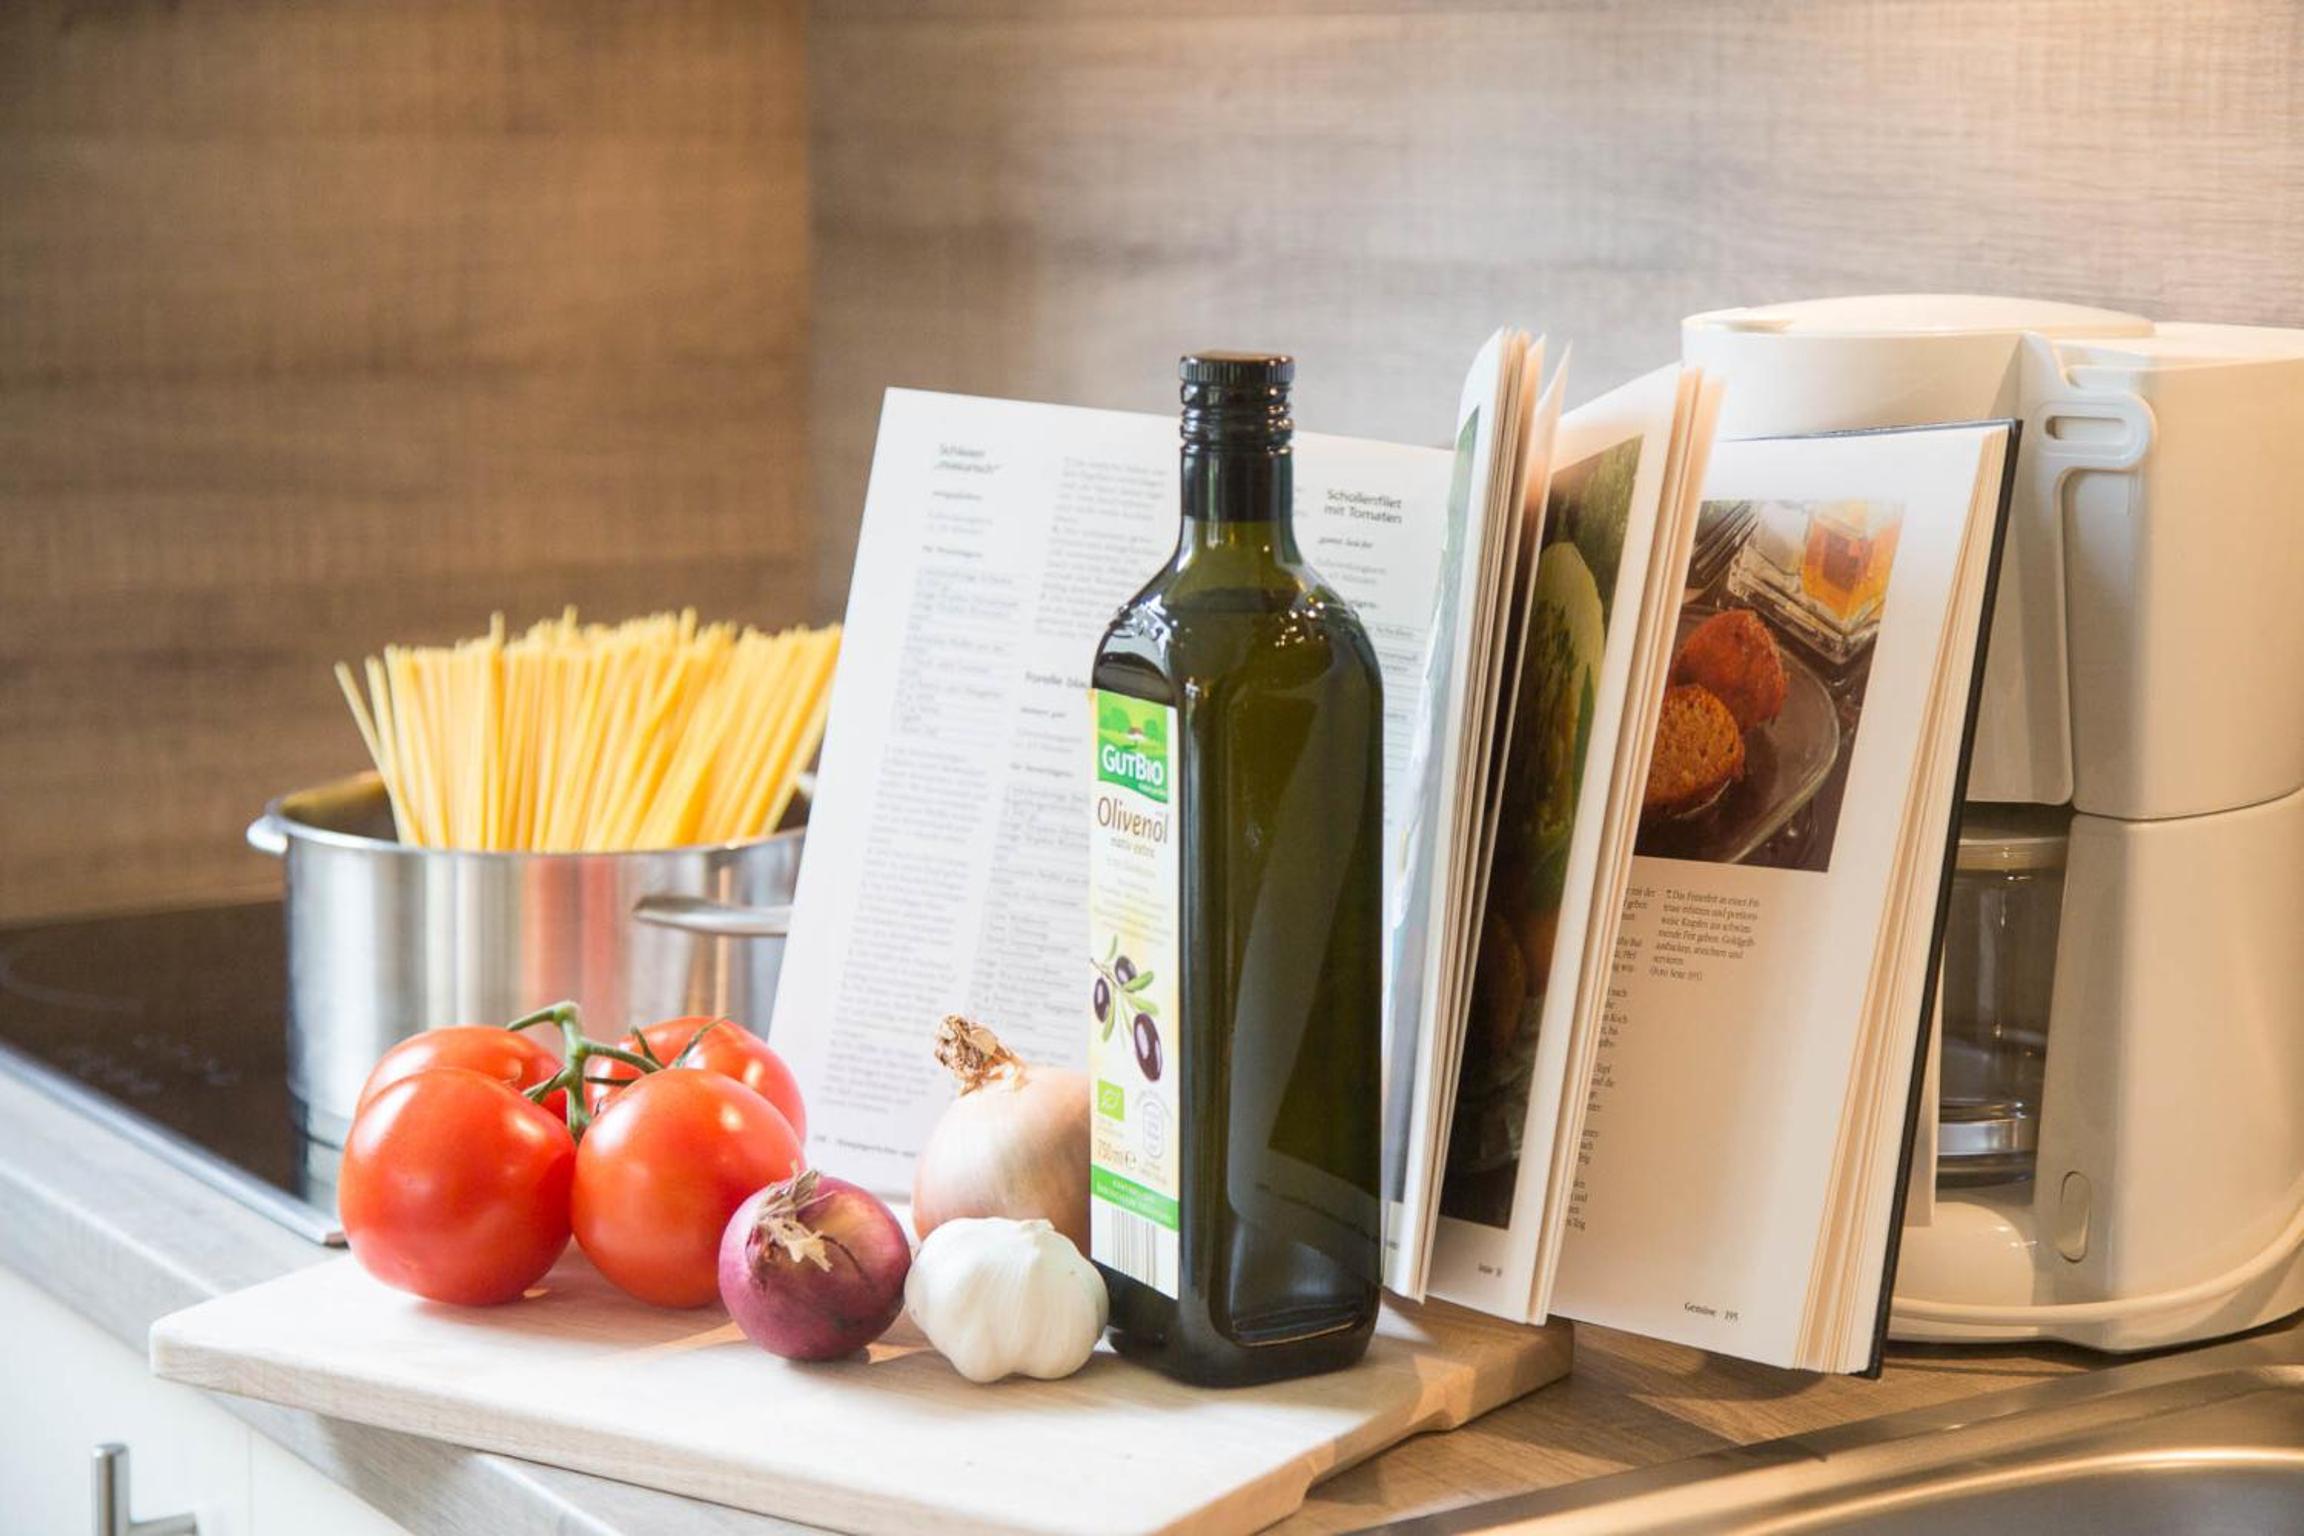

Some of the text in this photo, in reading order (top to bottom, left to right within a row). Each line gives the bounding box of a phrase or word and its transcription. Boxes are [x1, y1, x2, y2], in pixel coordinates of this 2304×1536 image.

[1324, 505, 1402, 524] mit Tomaten
[1102, 744, 1163, 786] GUTBIO
